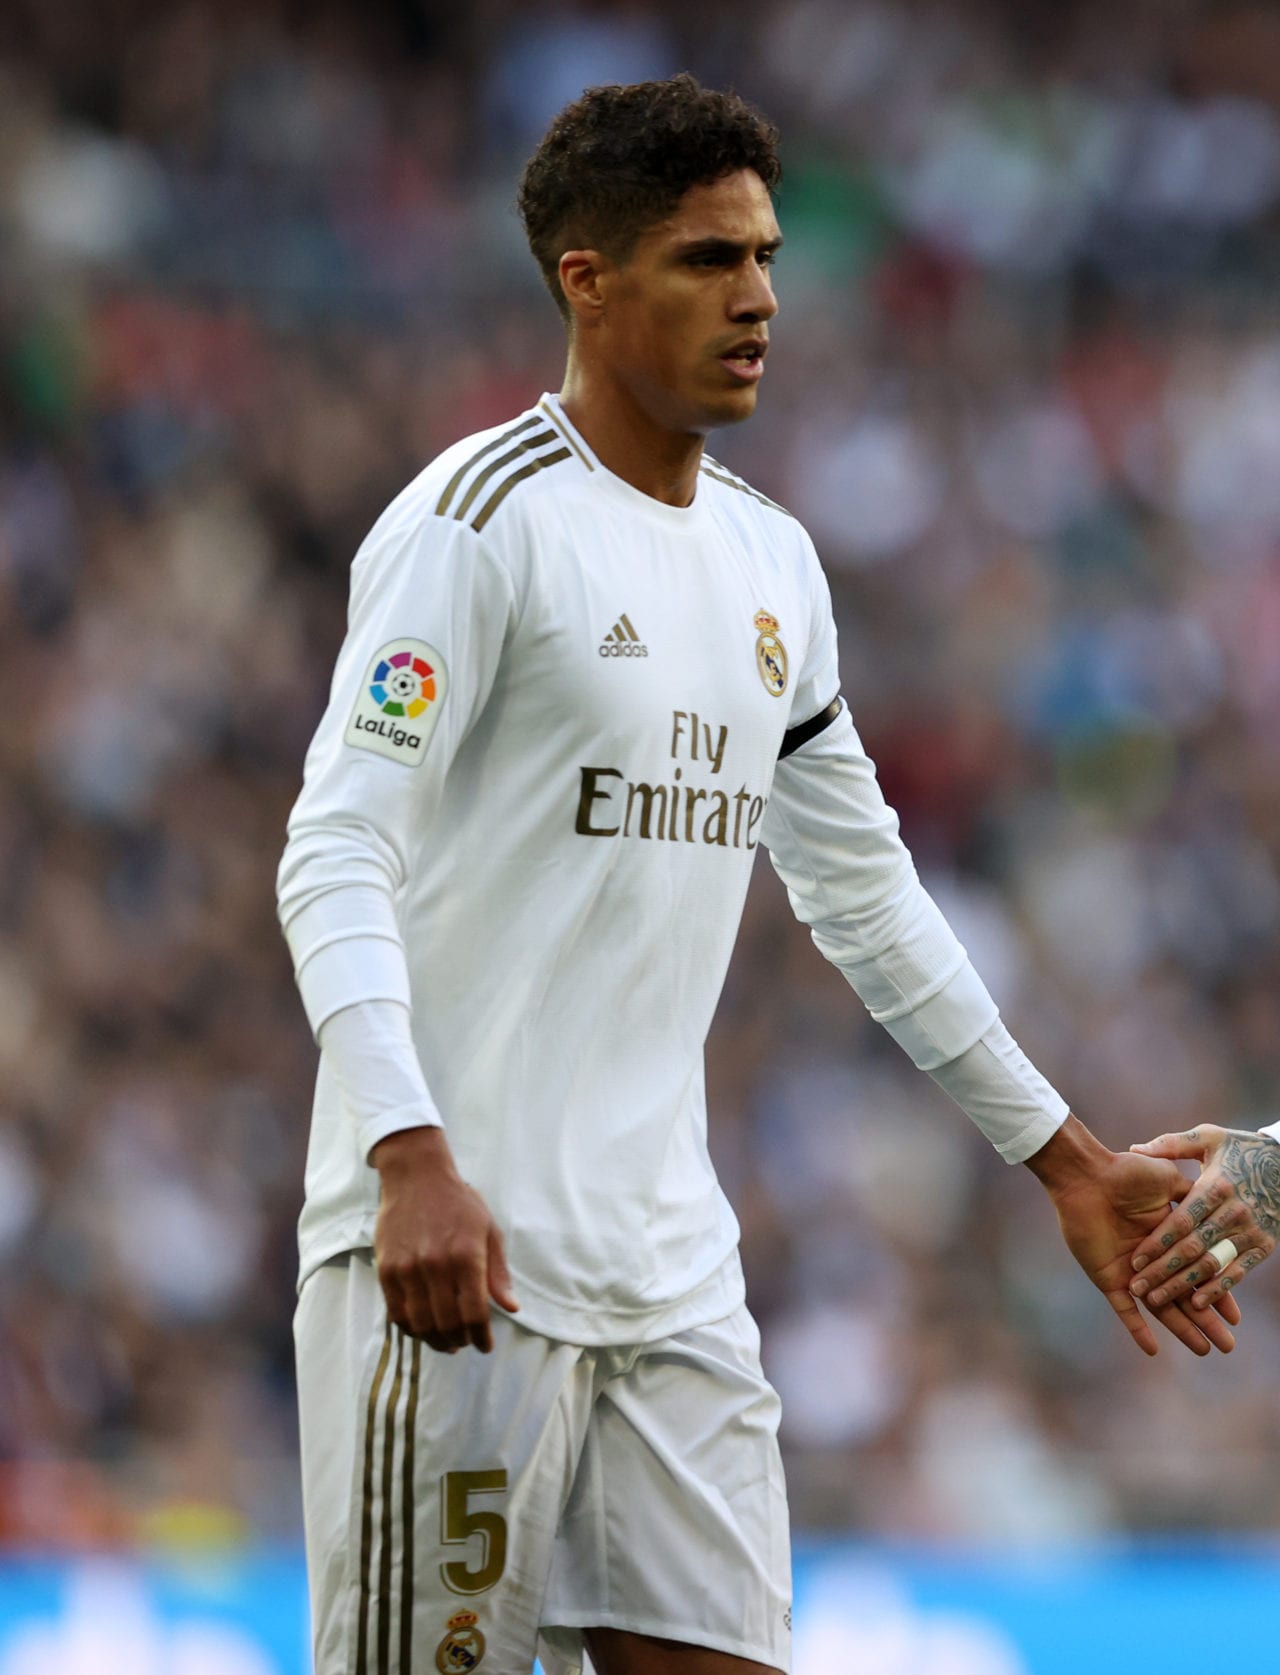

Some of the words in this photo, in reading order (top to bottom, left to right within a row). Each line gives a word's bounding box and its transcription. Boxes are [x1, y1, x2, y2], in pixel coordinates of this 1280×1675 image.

[598, 641, 649, 657] adidas
[355, 714, 421, 749] LaLiga
[671, 711, 728, 774] Fly
[575, 766, 768, 850] Emirate
[440, 1468, 508, 1596] 5
